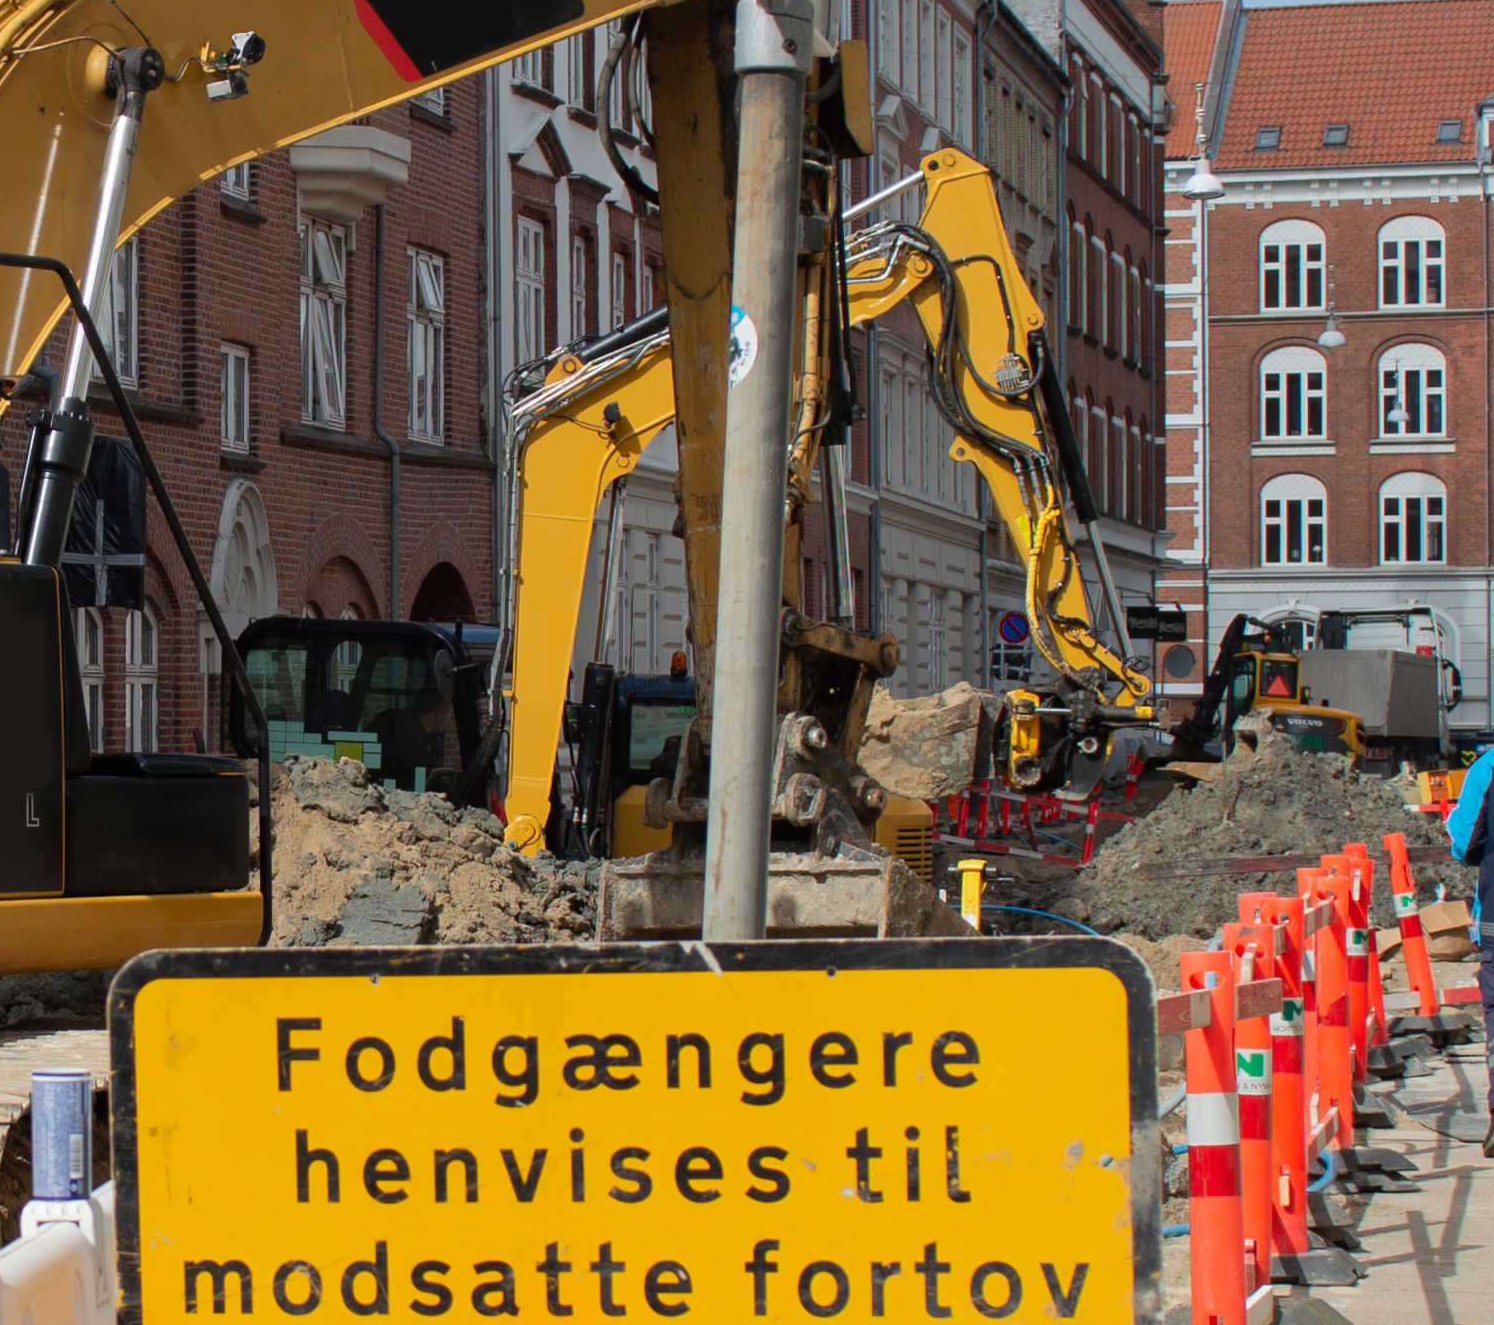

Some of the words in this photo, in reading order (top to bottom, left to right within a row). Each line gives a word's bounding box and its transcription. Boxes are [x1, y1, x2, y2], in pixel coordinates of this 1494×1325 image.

[1286, 717, 1324, 727] VOLVO
[276, 1015, 980, 1108] Fodgængere
[295, 1128, 791, 1205] henvises
[845, 1125, 972, 1204] til
[183, 1240, 694, 1318] modsatte
[744, 1239, 1090, 1319] fortov
